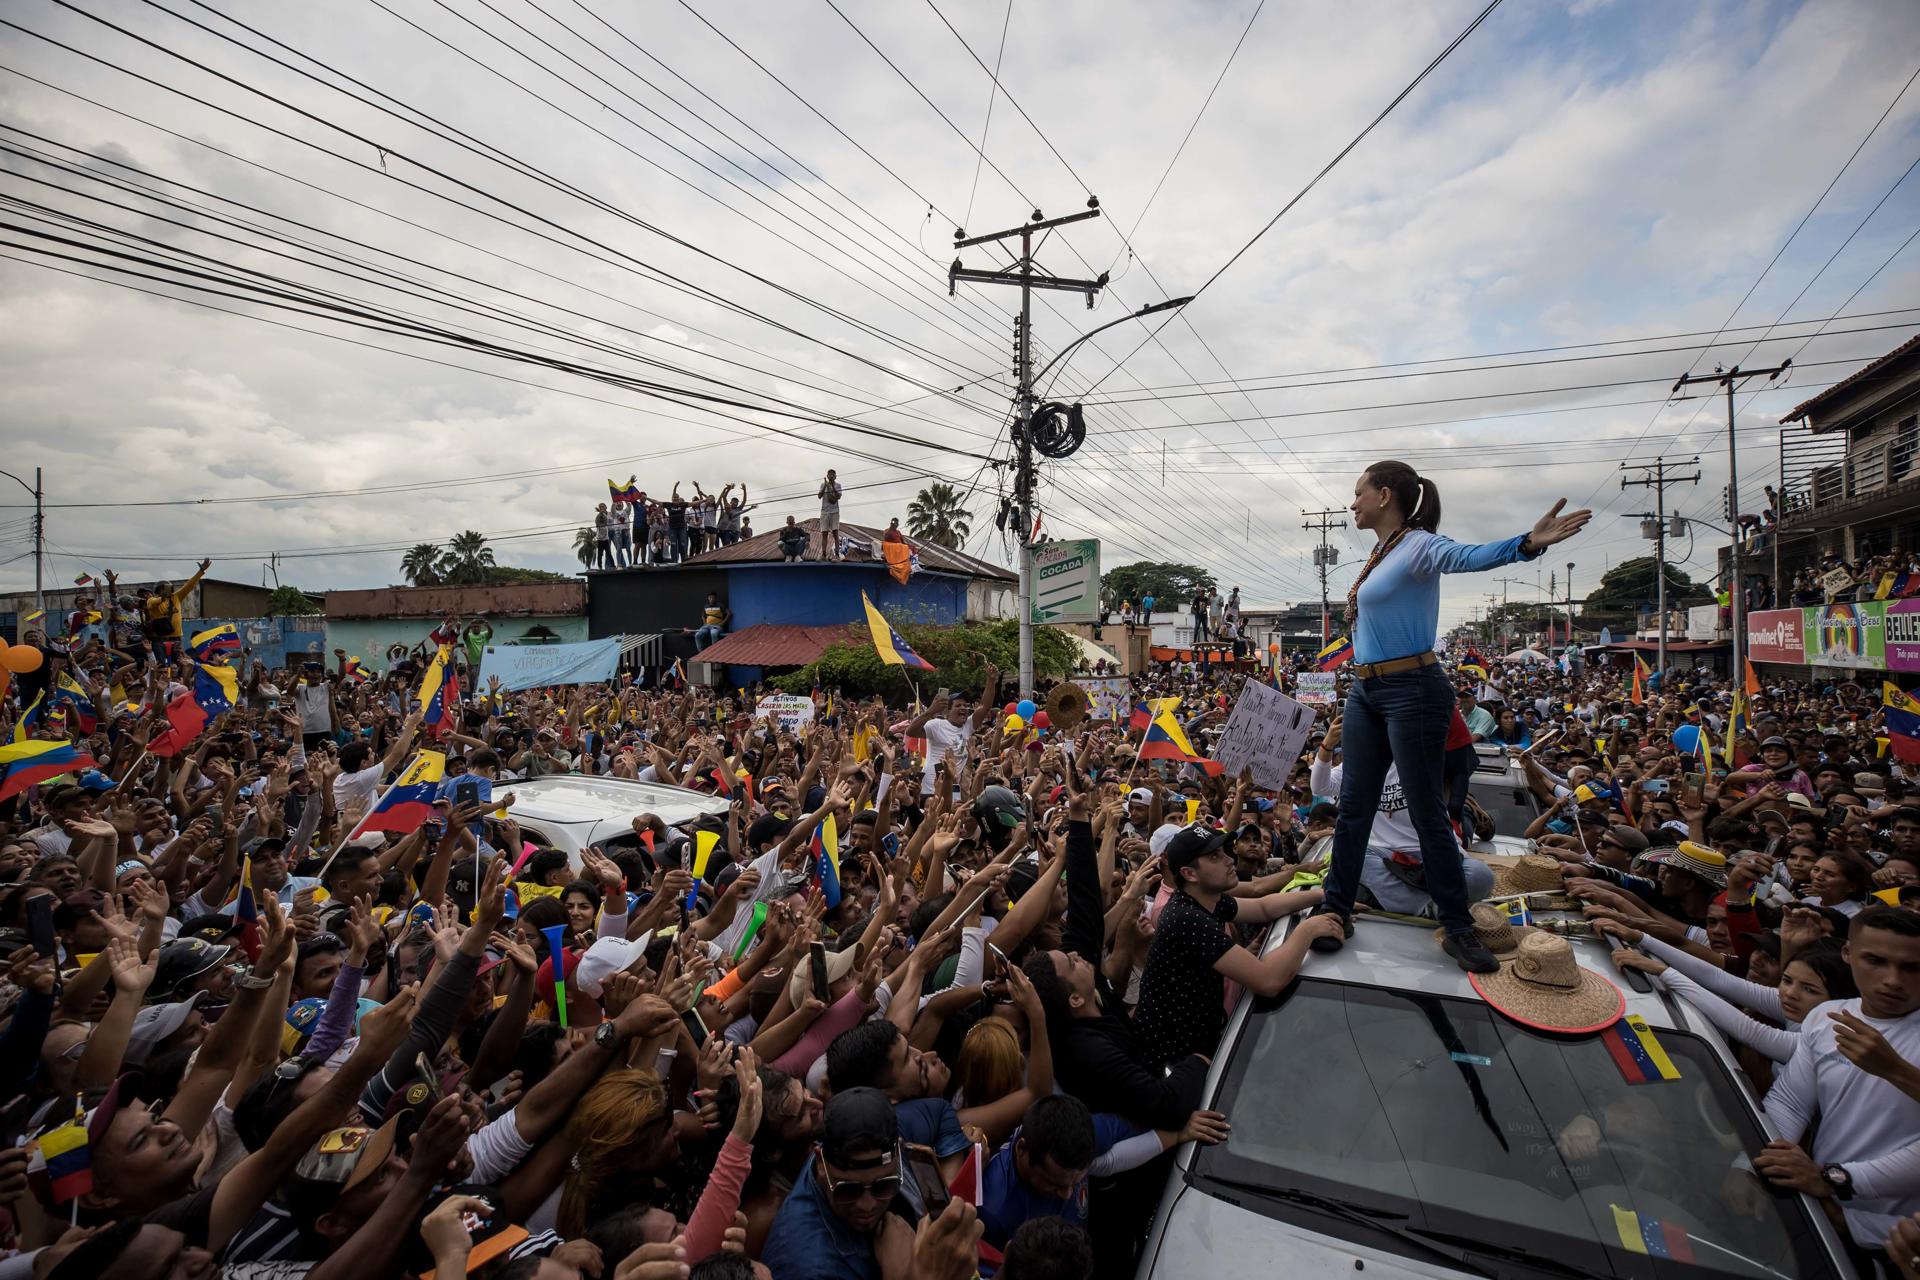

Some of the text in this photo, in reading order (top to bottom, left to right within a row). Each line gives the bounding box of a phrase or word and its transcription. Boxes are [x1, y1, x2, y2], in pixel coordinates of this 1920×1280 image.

[1041, 560, 1082, 578] COCADA
[1749, 628, 1777, 645] movilnet
[1886, 615, 1920, 642] BELLE
[513, 656, 553, 669] VIRGEN
